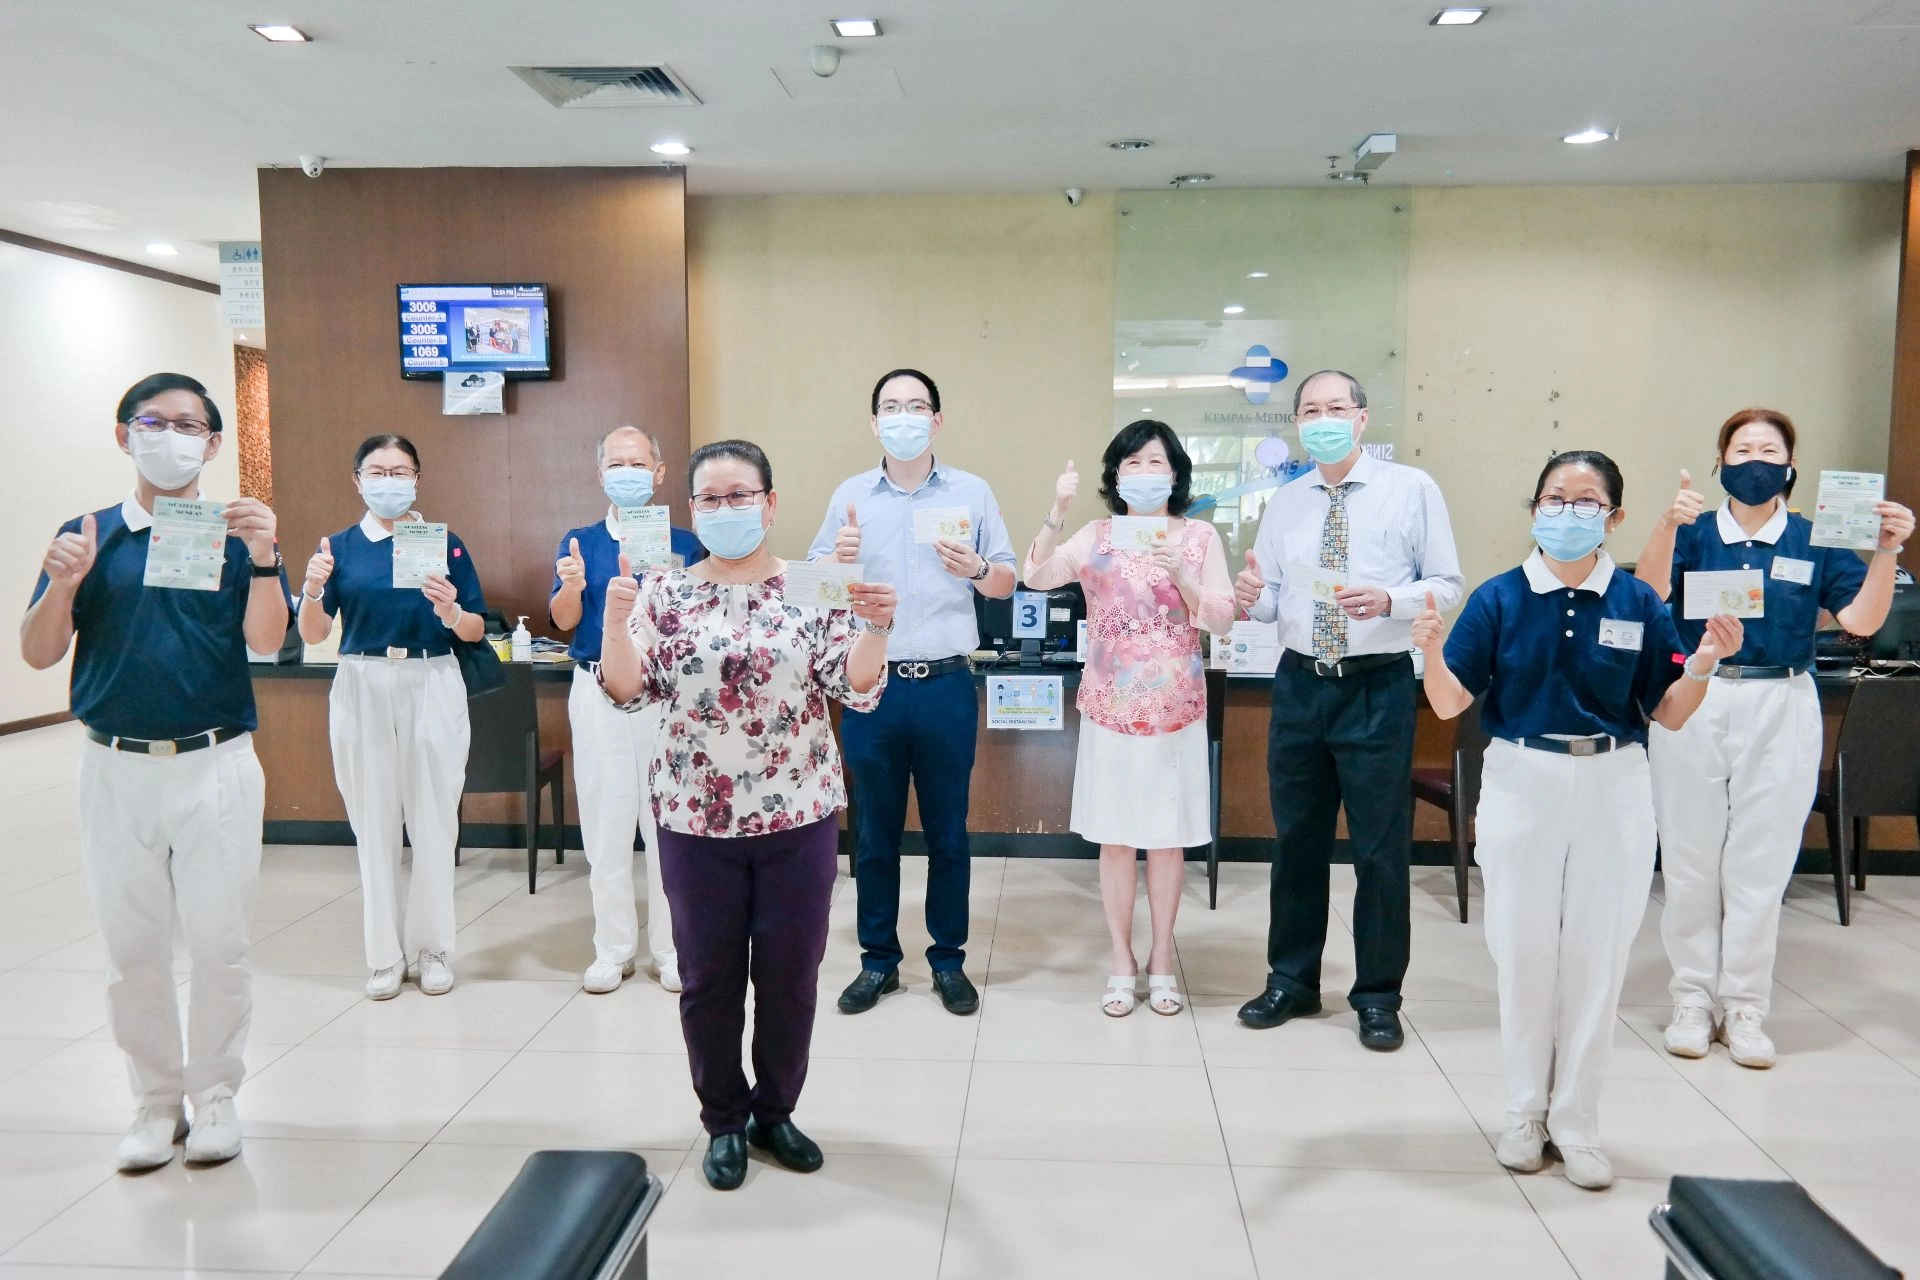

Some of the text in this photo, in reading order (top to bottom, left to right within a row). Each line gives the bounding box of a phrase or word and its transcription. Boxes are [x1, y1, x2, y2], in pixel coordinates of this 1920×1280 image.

[409, 301, 437, 312] 3006
[410, 323, 438, 335] 3005
[411, 346, 439, 357] 1069
[1204, 412, 1295, 424] KEMPAS MEDIC
[1021, 604, 1038, 628] 3
